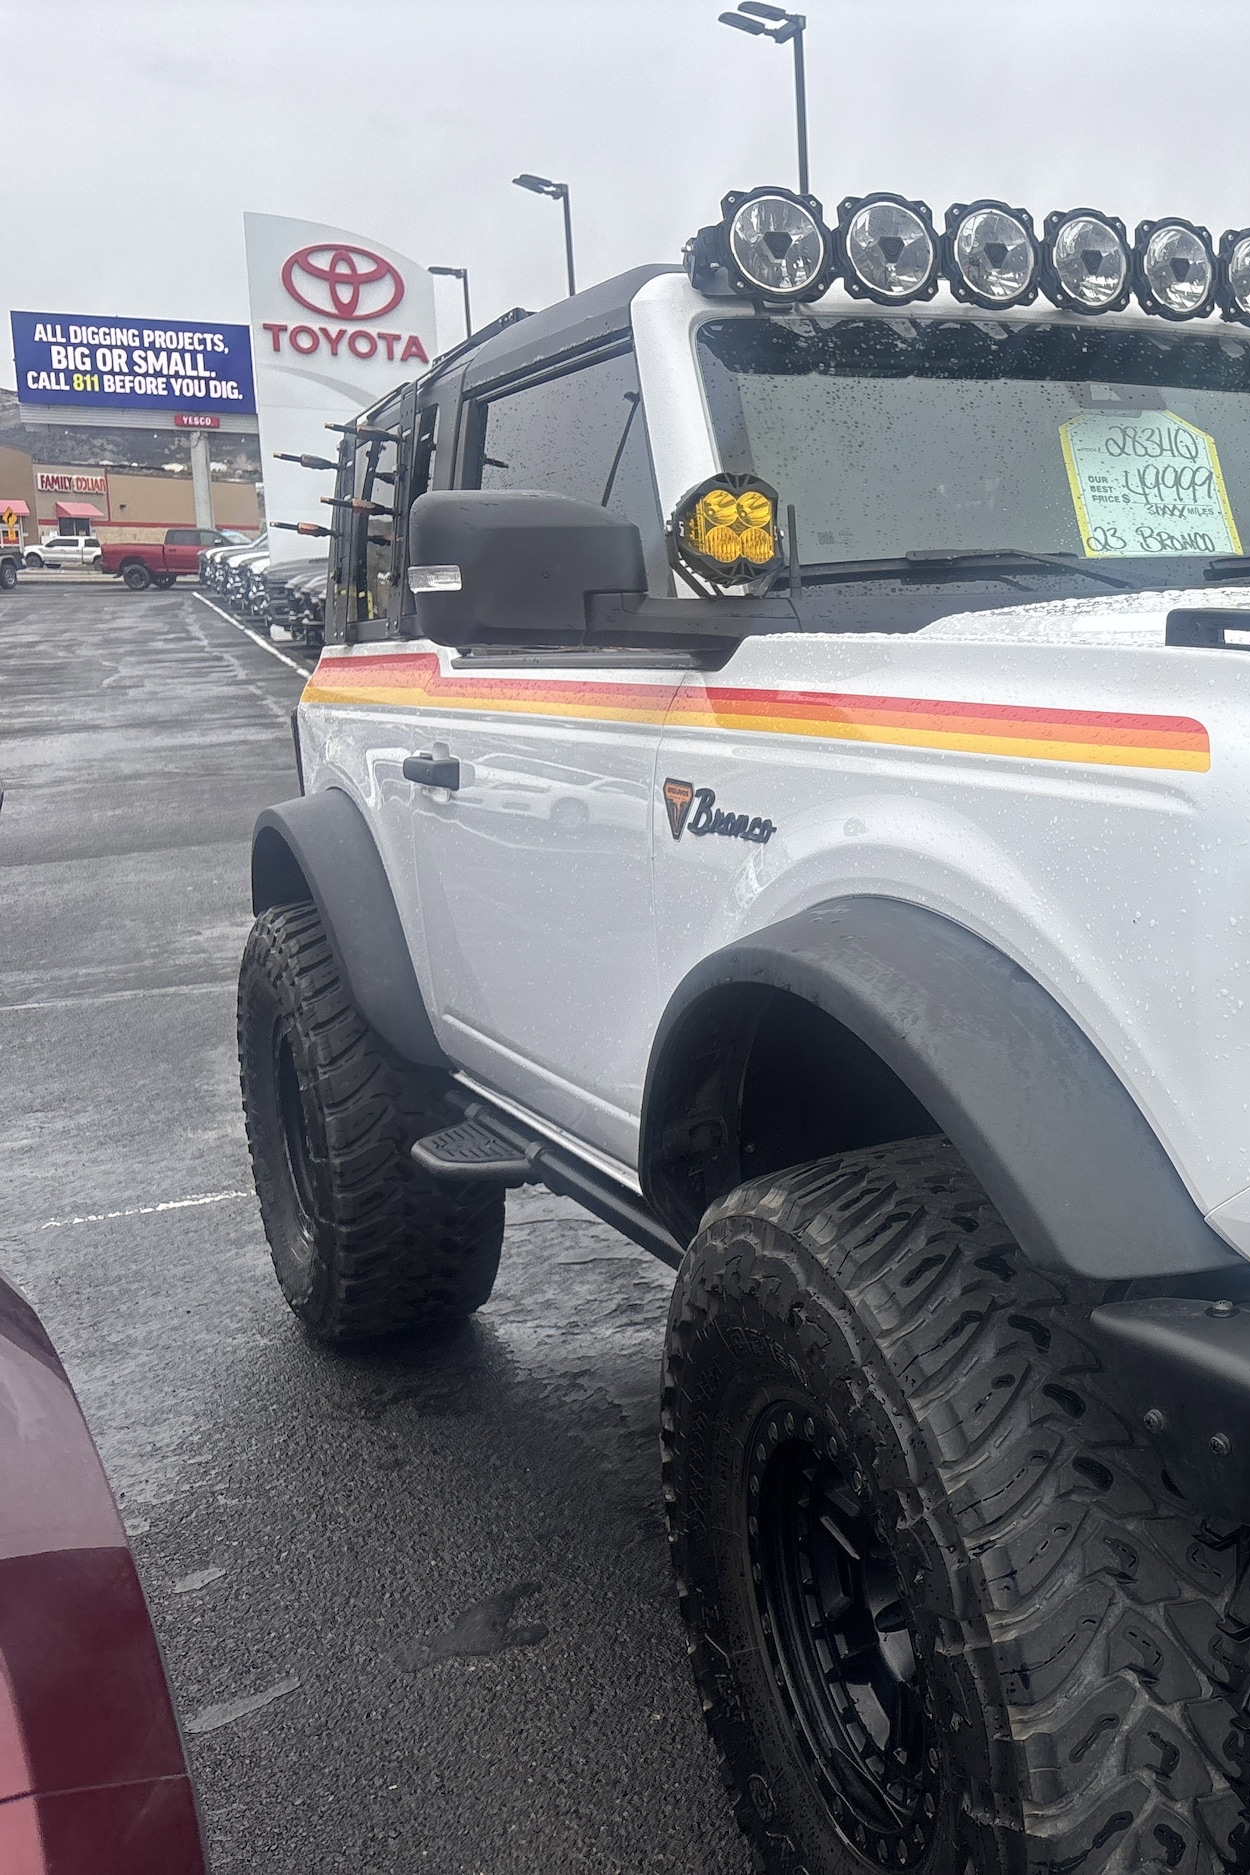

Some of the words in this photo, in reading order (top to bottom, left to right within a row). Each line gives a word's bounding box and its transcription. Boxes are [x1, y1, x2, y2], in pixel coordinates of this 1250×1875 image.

[34, 323, 66, 343] ALL
[69, 325, 140, 347] DIGGING
[143, 329, 229, 355] PROJECTS,
[263, 323, 429, 364] TOYOTA
[51, 345, 92, 371] BIG
[96, 347, 129, 373] OR
[132, 350, 216, 378] SMALL.
[27, 371, 70, 391] CALL
[73, 373, 99, 392] 811
[103, 374, 168, 396] BEFORE
[170, 377, 206, 398] YOU
[209, 380, 244, 400] DIG.
[182, 416, 211, 426] YESCO
[40, 474, 73, 490] FAMILY
[1088, 475, 1108, 484] OUR
[1090, 485, 1113, 494] BEST
[1123, 464, 1214, 504] 49999
[1187, 508, 1214, 517] MILES
[1087, 526, 1127, 552] 23
[687, 788, 777, 844] Bronco
